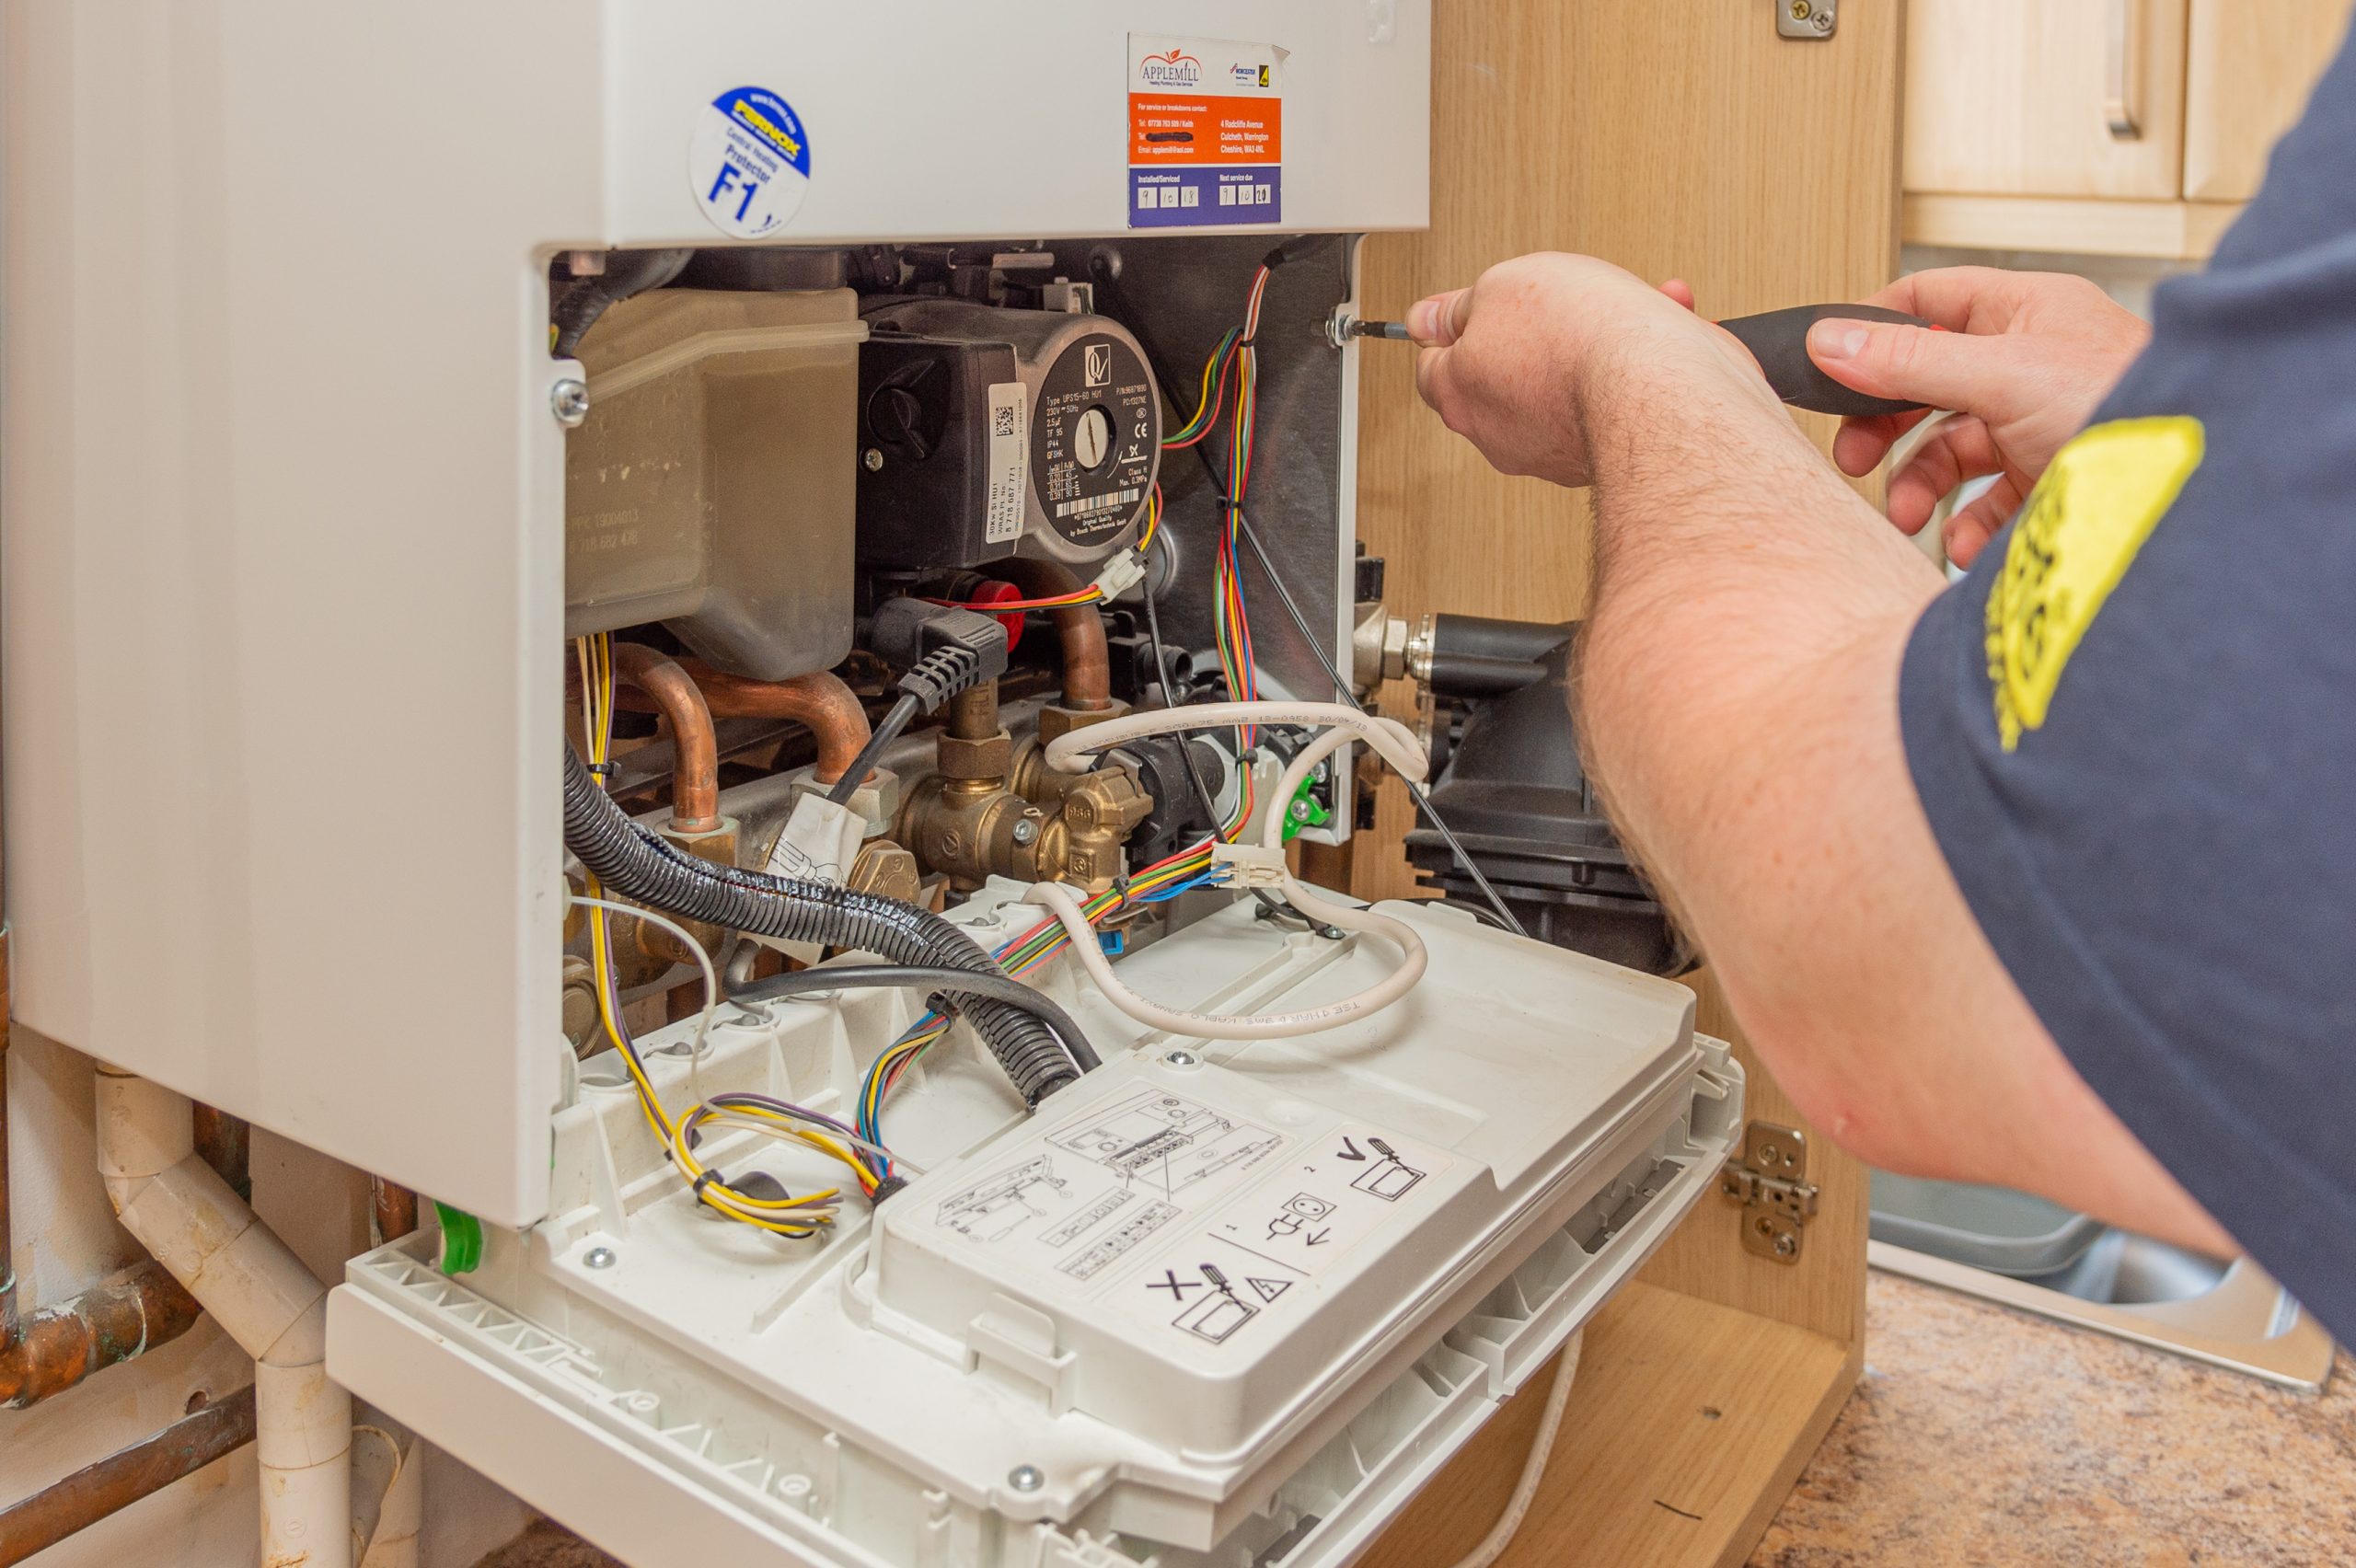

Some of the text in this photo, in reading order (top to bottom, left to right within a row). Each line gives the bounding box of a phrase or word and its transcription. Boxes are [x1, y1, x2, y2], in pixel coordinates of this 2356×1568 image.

[1142, 62, 1199, 82] APPLEMILL
[733, 98, 802, 157] FERNOX
[1244, 133, 1269, 143] Warrington
[726, 127, 752, 151] Central
[753, 147, 780, 173] Heating
[725, 144, 771, 184] Protector
[1219, 174, 1230, 182] Next
[708, 160, 759, 223] F1
[1046, 396, 1060, 407] Type
[1062, 391, 1090, 403] UPS15-60
[1046, 405, 1079, 417] 230V 50Hz
[1046, 428, 1063, 438] TF 95
[1046, 440, 1059, 449] IP44
[1127, 467, 1142, 477] Class
[1119, 478, 1130, 487] Max.
[1082, 515, 1113, 527] Original Quality
[1077, 527, 1089, 536] Bosch
[1332, 1000, 1360, 1013] TSE
[1190, 1013, 1237, 1024] KABLO
